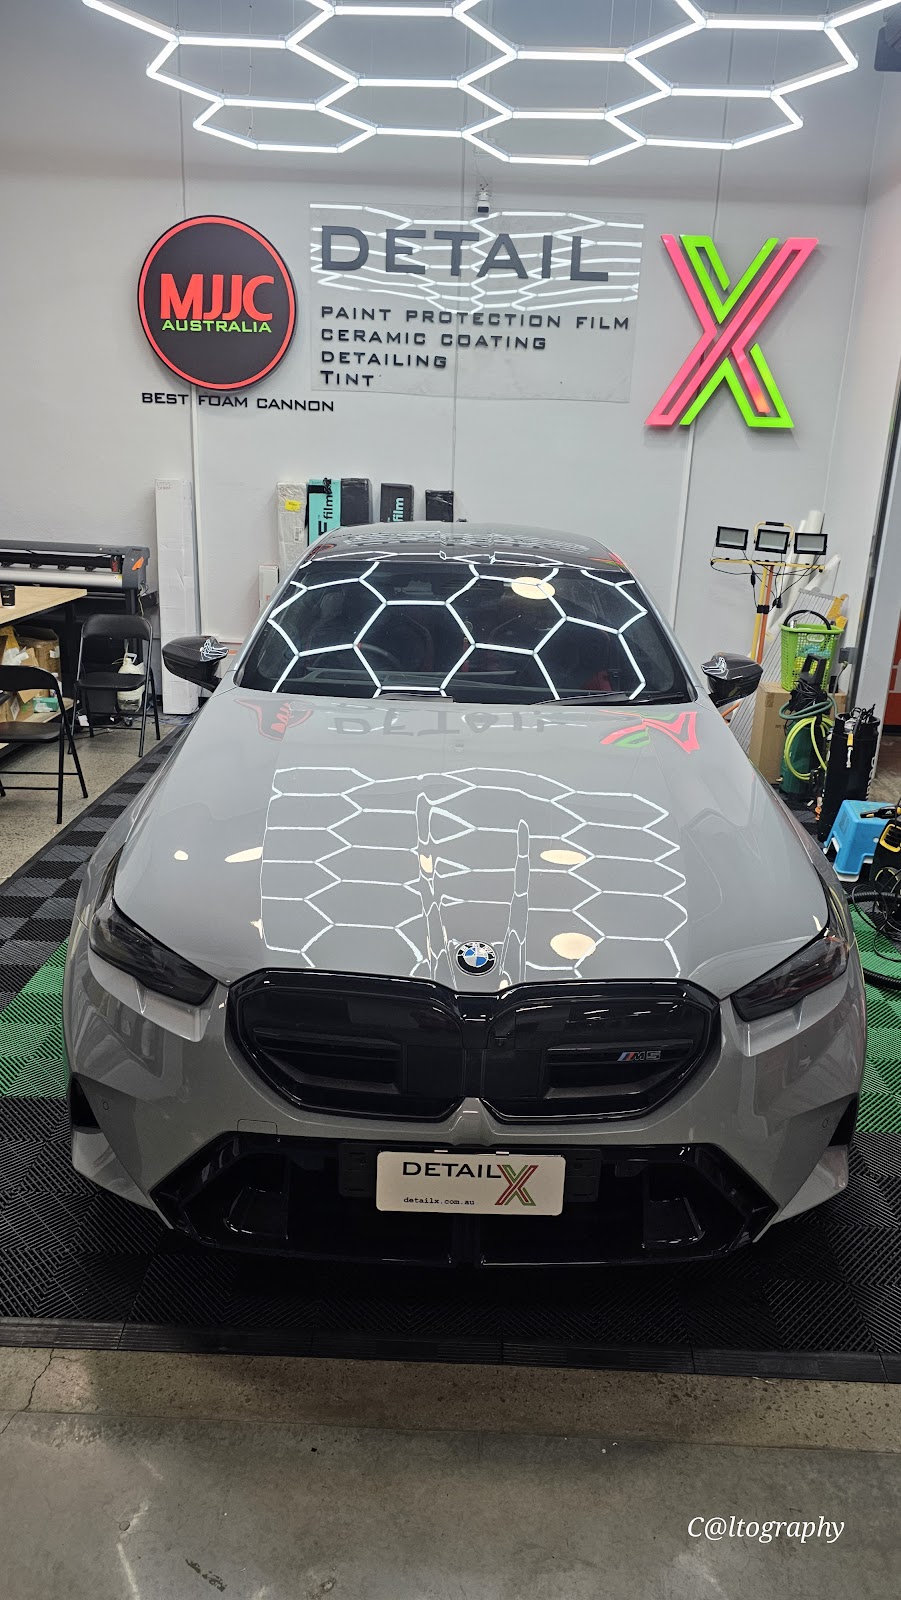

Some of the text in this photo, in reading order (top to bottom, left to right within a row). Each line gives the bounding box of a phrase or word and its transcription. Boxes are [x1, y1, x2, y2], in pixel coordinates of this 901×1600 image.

[160, 273, 274, 321] MJJC
[162, 320, 272, 333] AUSTRALIA
[321, 305, 629, 330] PAINT PROTECTION FILM
[321, 225, 819, 428] DETAIL X
[321, 328, 546, 350] CERAMIC COATING
[321, 351, 447, 369] DETAILING
[142, 392, 334, 412] BEST FOAM CANNON
[323, 495, 333, 519] film
[403, 1197, 475, 1206] detailx.com.au
